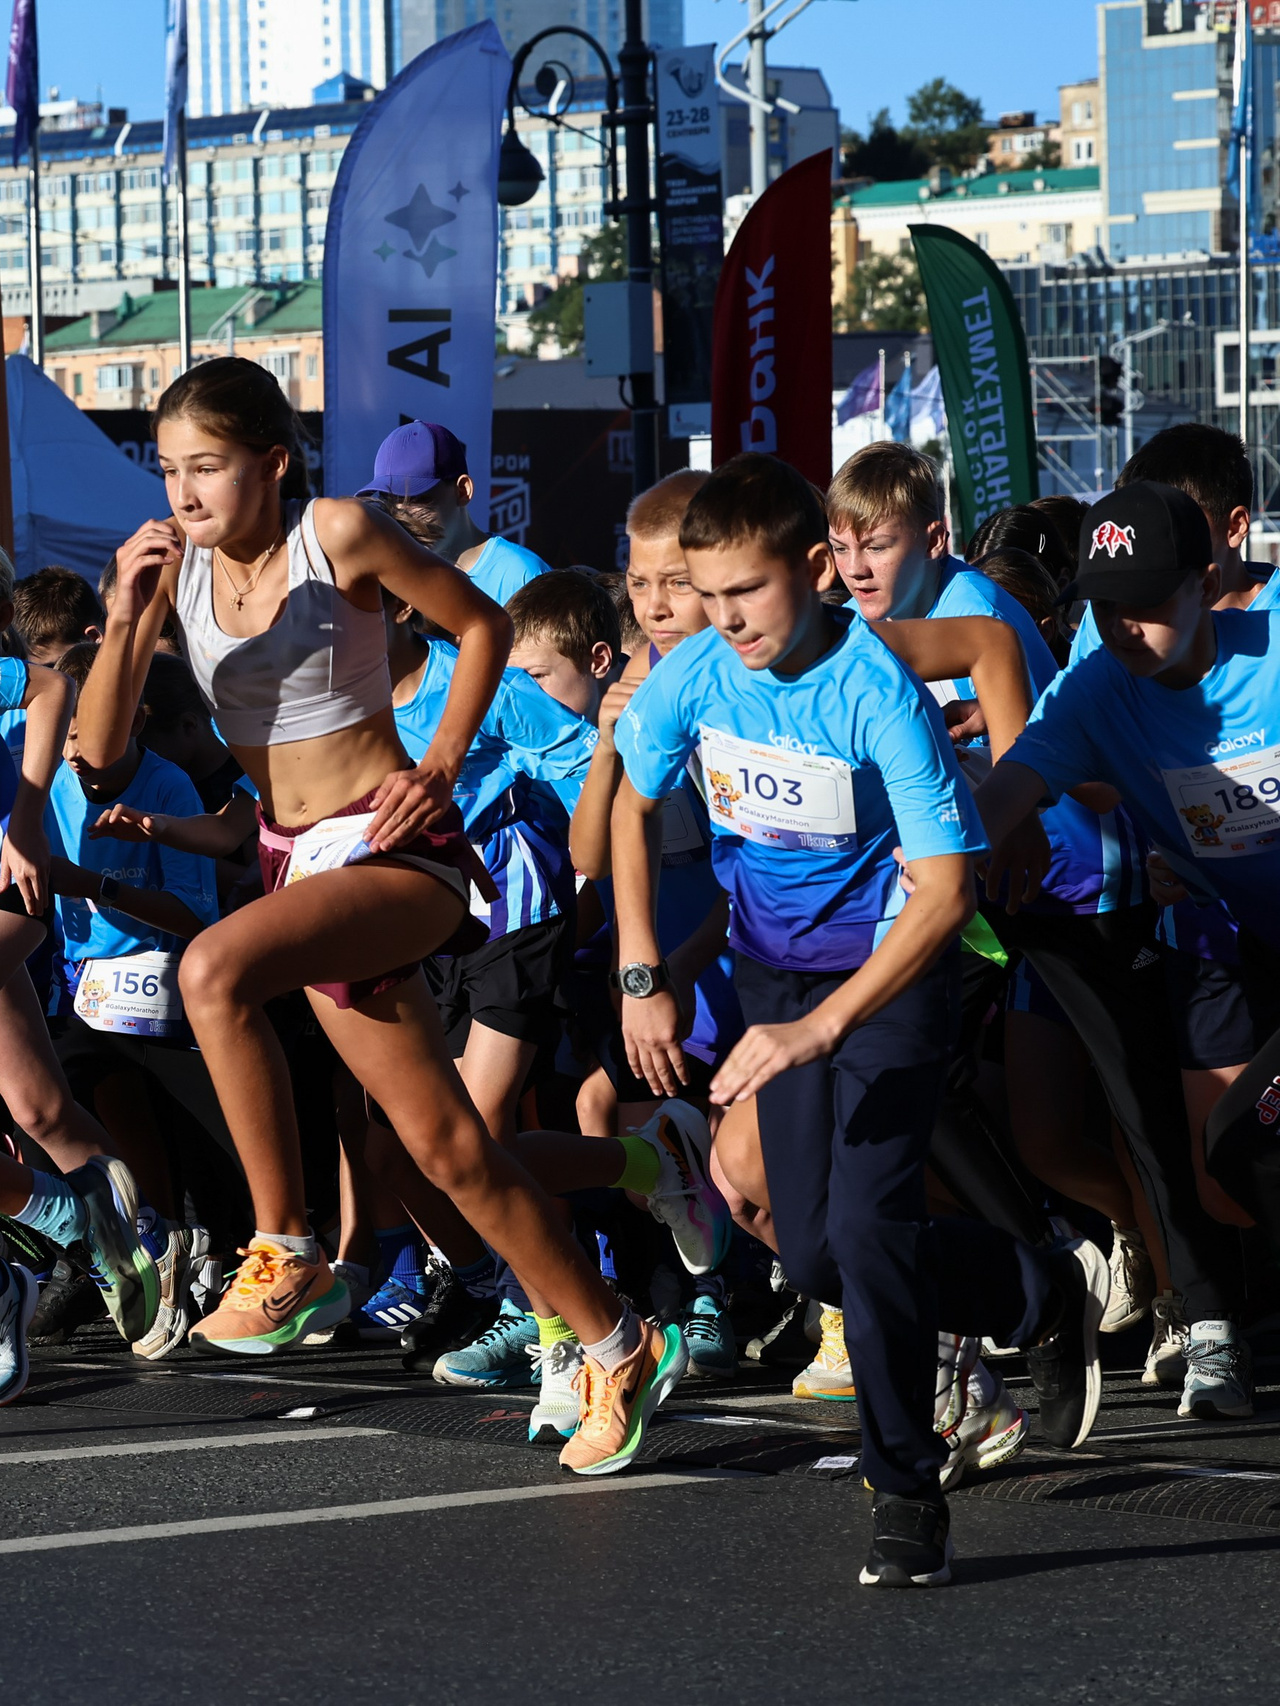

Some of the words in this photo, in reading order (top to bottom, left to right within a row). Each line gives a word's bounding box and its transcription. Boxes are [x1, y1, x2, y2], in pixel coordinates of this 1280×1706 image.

[666, 106, 710, 127] 23-28
[387, 309, 451, 388] AI
[1204, 728, 1266, 756] Galaxy
[738, 768, 804, 806] 103
[1214, 777, 1280, 815] 189
[738, 805, 810, 828] #GalaxyMarathon
[101, 867, 150, 880] Galaxy
[1132, 953, 1160, 970] adidas
[112, 971, 159, 997] 156
[105, 1003, 159, 1015] #GalaxyMarathon
